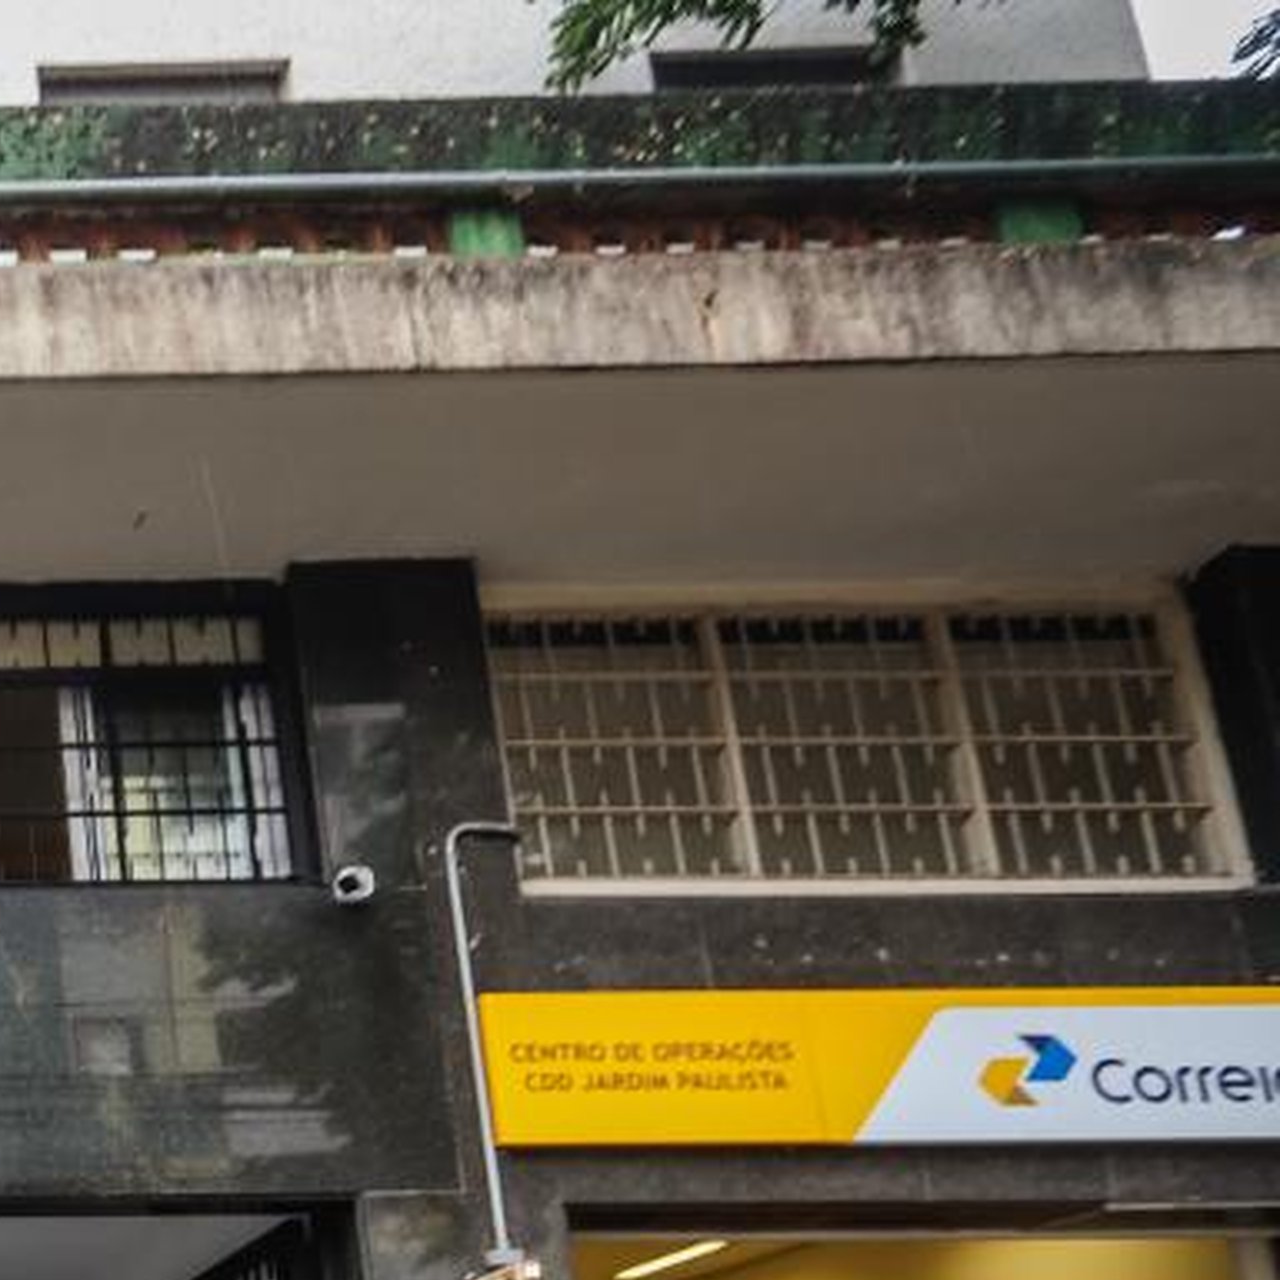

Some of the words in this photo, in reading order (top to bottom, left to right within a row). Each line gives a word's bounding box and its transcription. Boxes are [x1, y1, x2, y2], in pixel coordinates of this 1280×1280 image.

[510, 1042, 606, 1062] CENTRO
[614, 1042, 644, 1061] DE
[582, 1071, 669, 1092] JARDIM
[677, 1070, 787, 1091] PAULISTA
[1092, 1059, 1280, 1104] Correi
